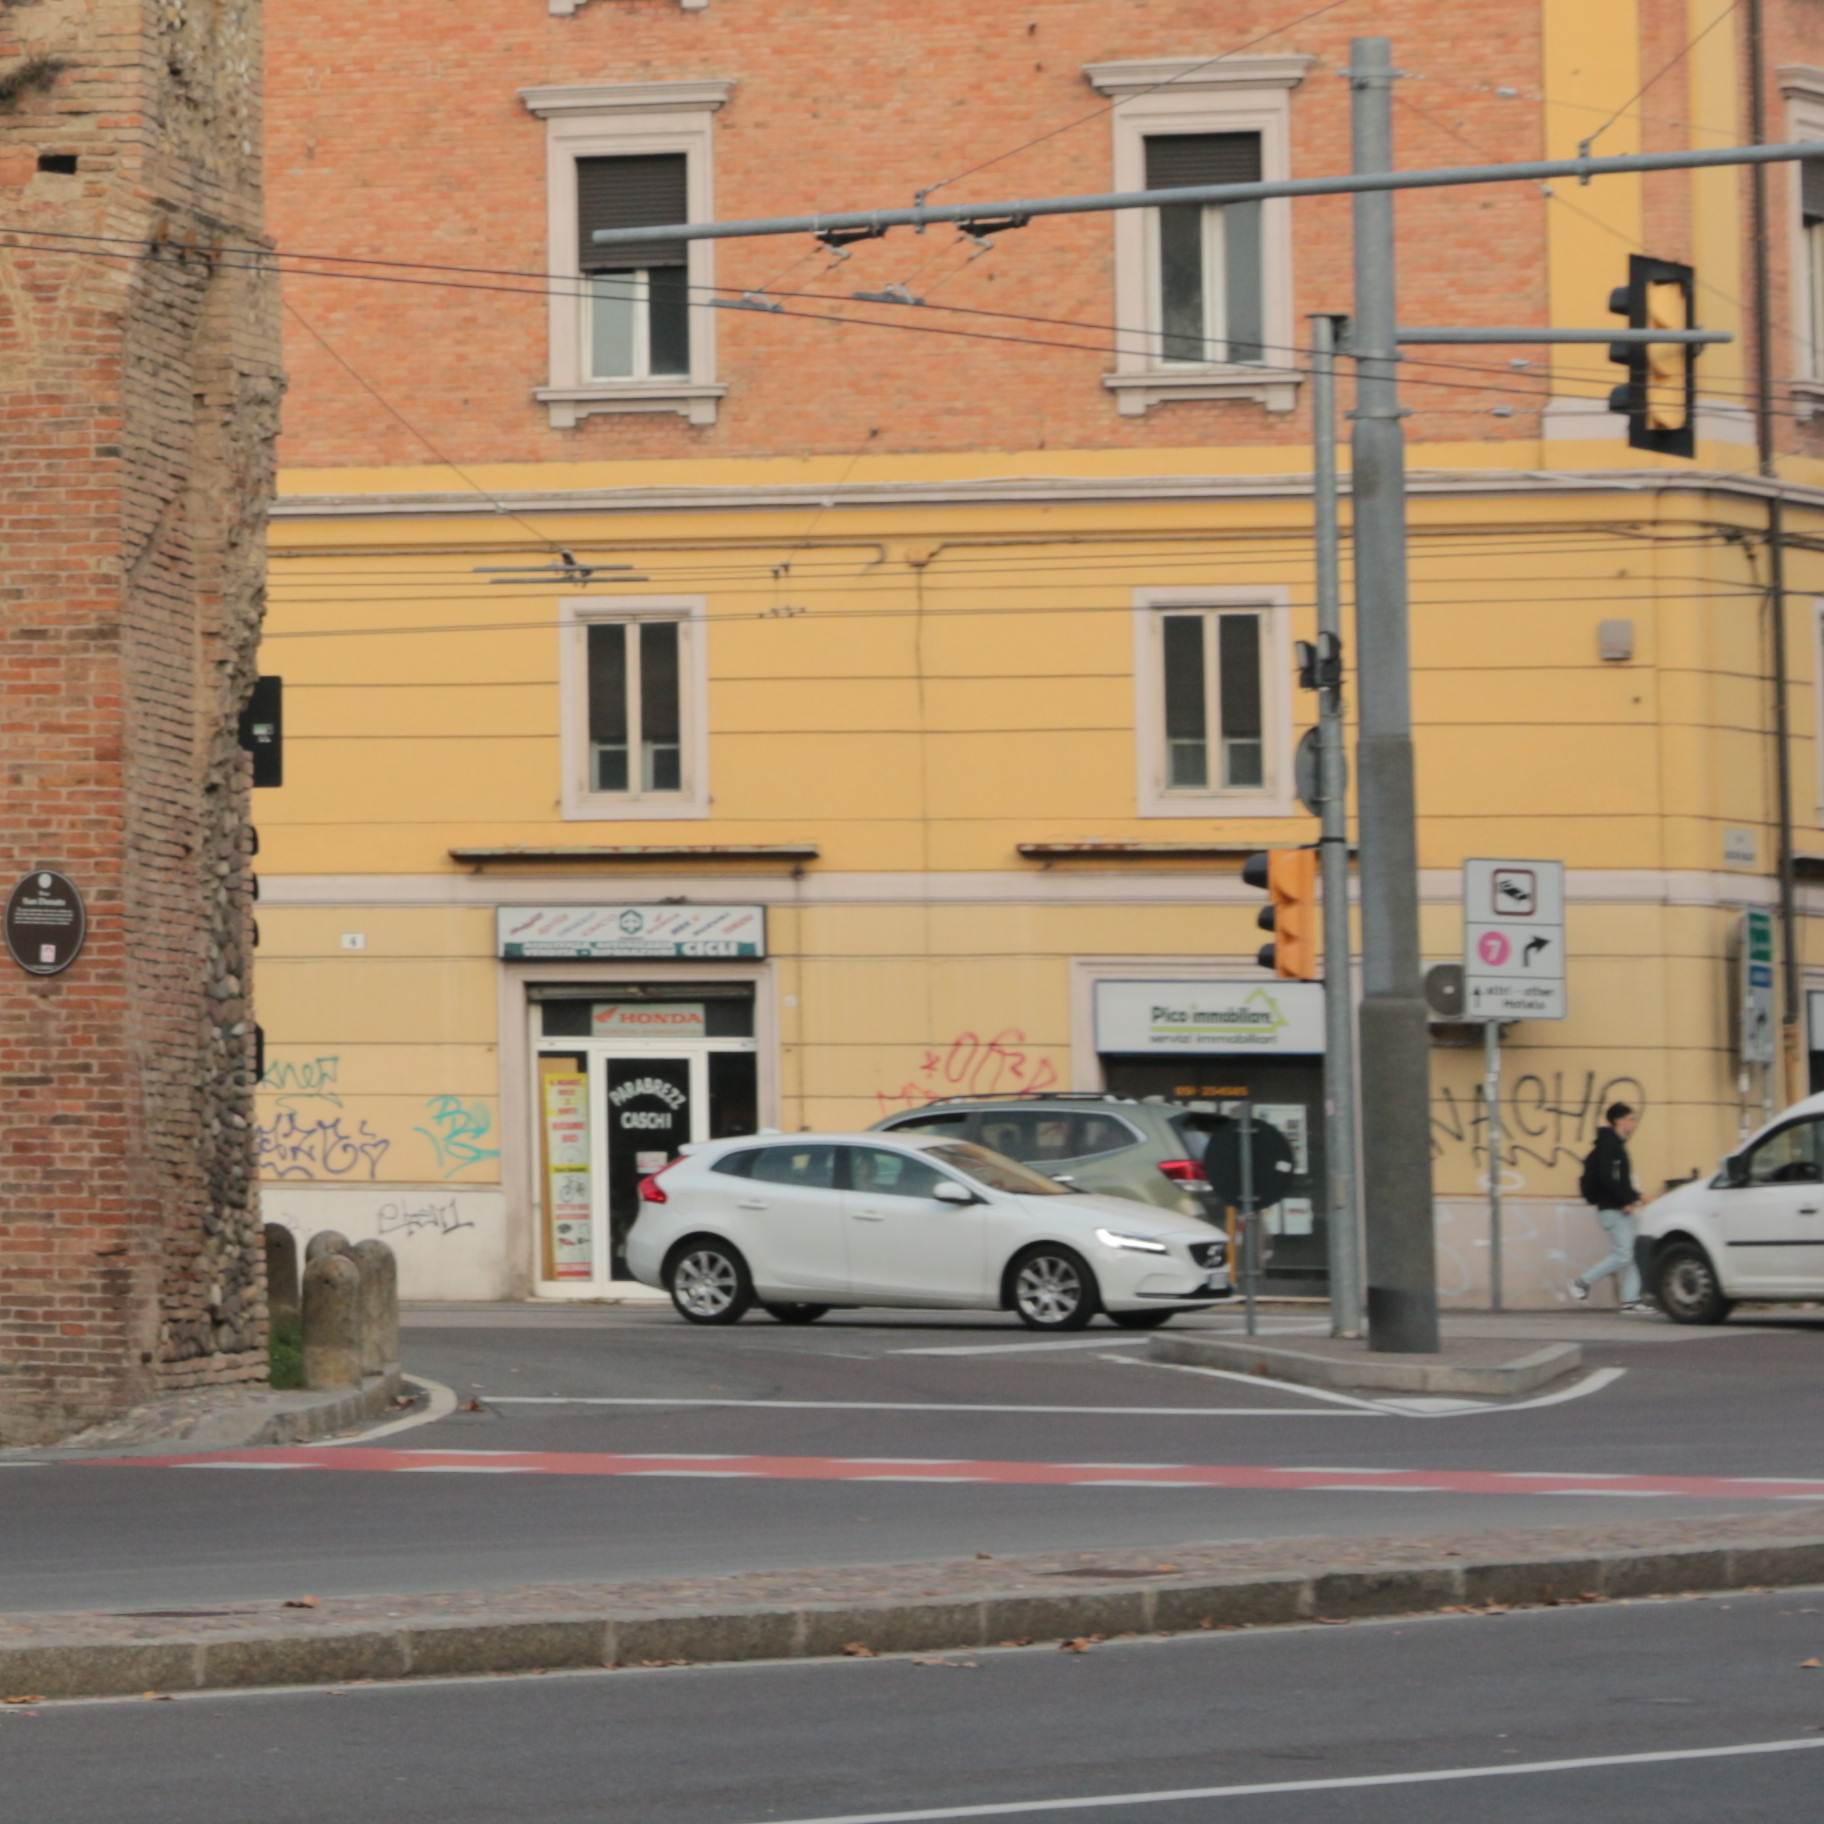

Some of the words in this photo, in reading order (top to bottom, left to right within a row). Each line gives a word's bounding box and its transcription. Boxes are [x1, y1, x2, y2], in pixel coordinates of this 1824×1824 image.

[682, 942, 739, 957] CICLI
[1484, 939, 1503, 961] 7
[619, 1013, 704, 1025] HONDA
[620, 1111, 673, 1130] CASCHI
